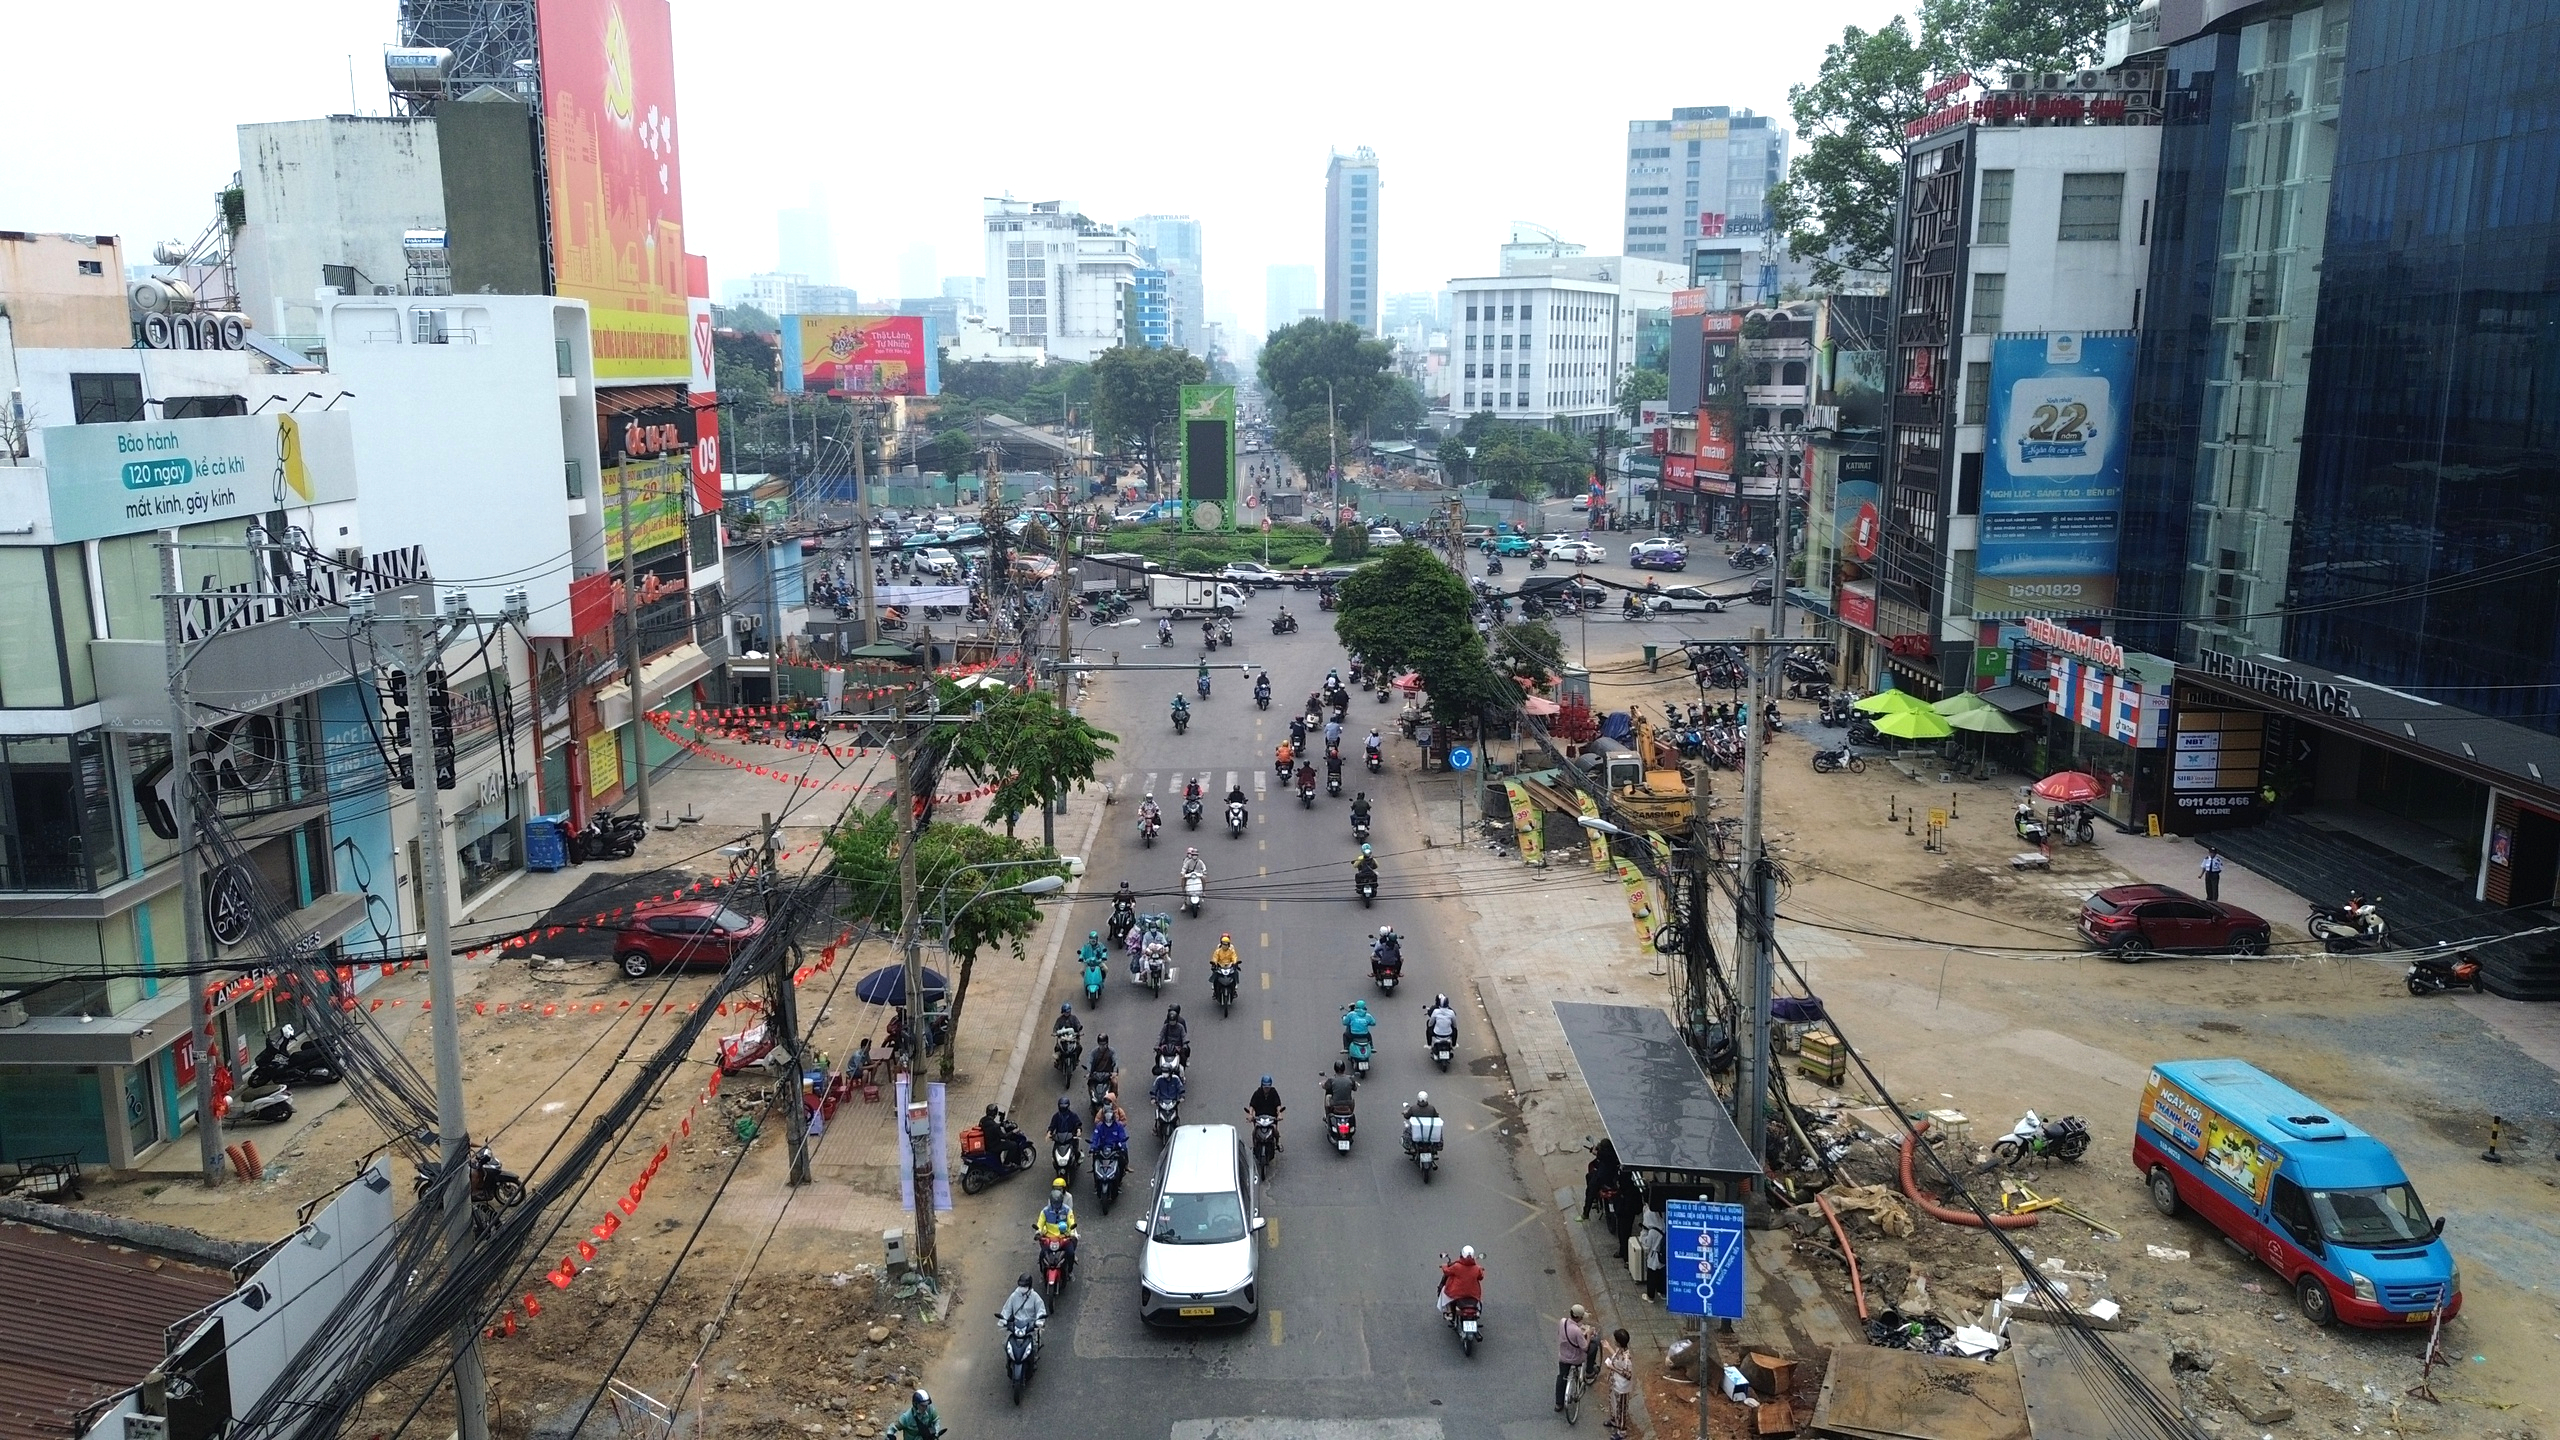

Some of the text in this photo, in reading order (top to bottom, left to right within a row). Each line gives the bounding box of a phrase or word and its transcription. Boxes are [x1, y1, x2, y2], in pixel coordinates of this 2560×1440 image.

[141, 311, 247, 350] anna
[2029, 402, 2087, 440] 22
[117, 432, 179, 453] Bảo hành
[699, 436, 717, 474] 09
[128, 456, 245, 486] 120 ngày kể cả khi
[1845, 462, 1872, 471] KATINAT
[126, 488, 236, 519] mất kính, gãy kính
[177, 575, 270, 643] KÍNH
[357, 545, 433, 596] ANNA
[2008, 584, 2081, 597] 19001829
[2025, 616, 2125, 669] THIÊN NAM HÒA
[2201, 648, 2351, 718] THE INTERLACE
[1632, 810, 1681, 819] SAMSUNG
[217, 907, 252, 934] anna
[2154, 1100, 2182, 1124] THÀNH
[2182, 1117, 2203, 1139] VIÊN
[2160, 1088, 2203, 1122] NGÀY HỘI
